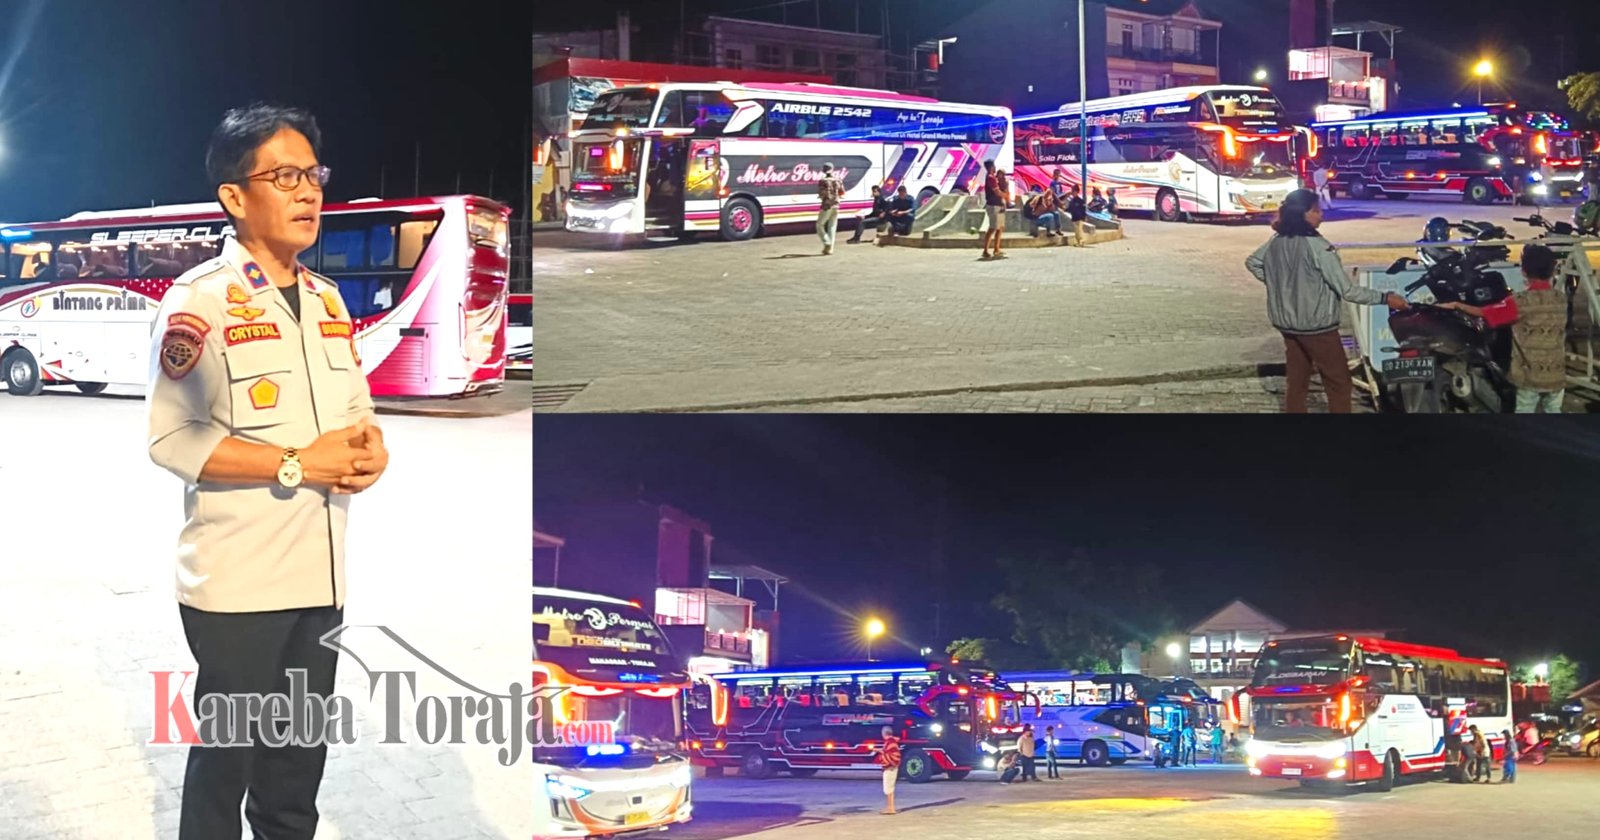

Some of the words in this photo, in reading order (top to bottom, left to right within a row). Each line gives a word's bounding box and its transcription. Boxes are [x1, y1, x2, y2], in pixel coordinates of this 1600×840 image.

[771, 103, 831, 115] AIRBUS
[833, 106, 872, 117] 2542
[737, 163, 790, 183] Metro
[229, 325, 279, 341] CRYSTAL
[542, 605, 583, 621] Metro
[607, 613, 654, 630] Permai
